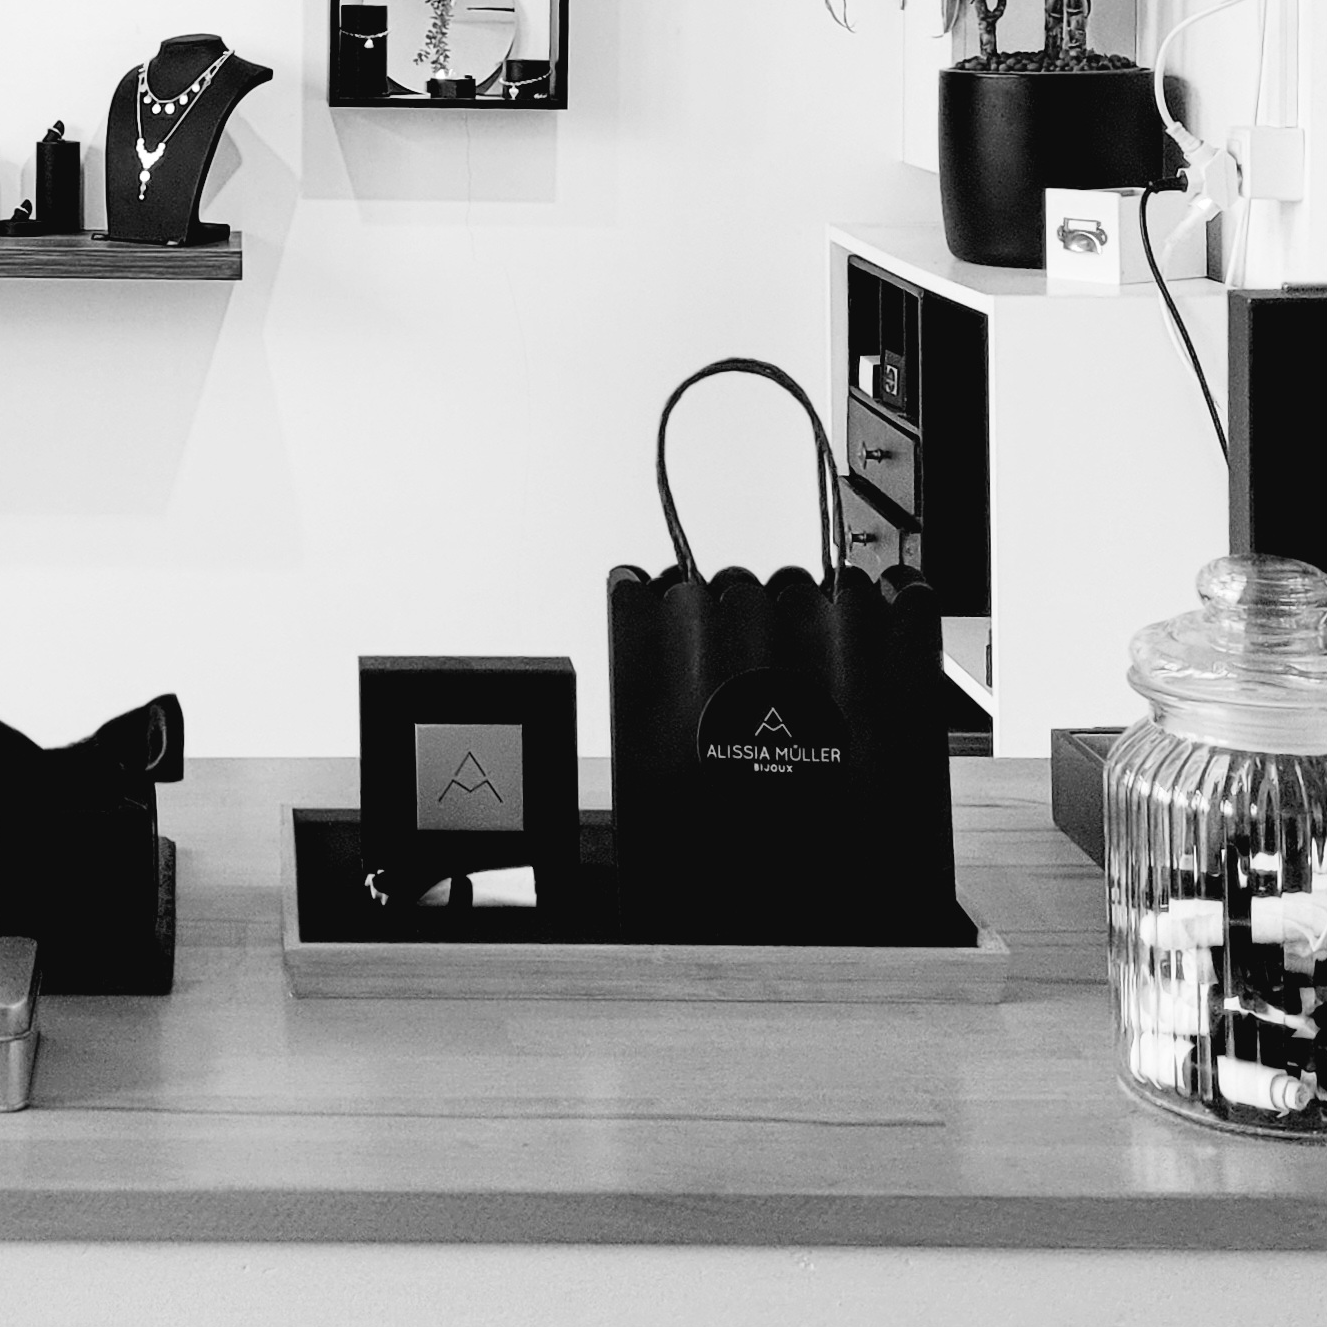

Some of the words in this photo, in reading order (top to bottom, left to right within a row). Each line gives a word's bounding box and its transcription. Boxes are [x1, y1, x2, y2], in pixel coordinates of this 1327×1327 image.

[706, 744, 770, 760] ALISSIA
[775, 744, 841, 762] MÜLLER
[753, 763, 793, 773] BIJOUX
